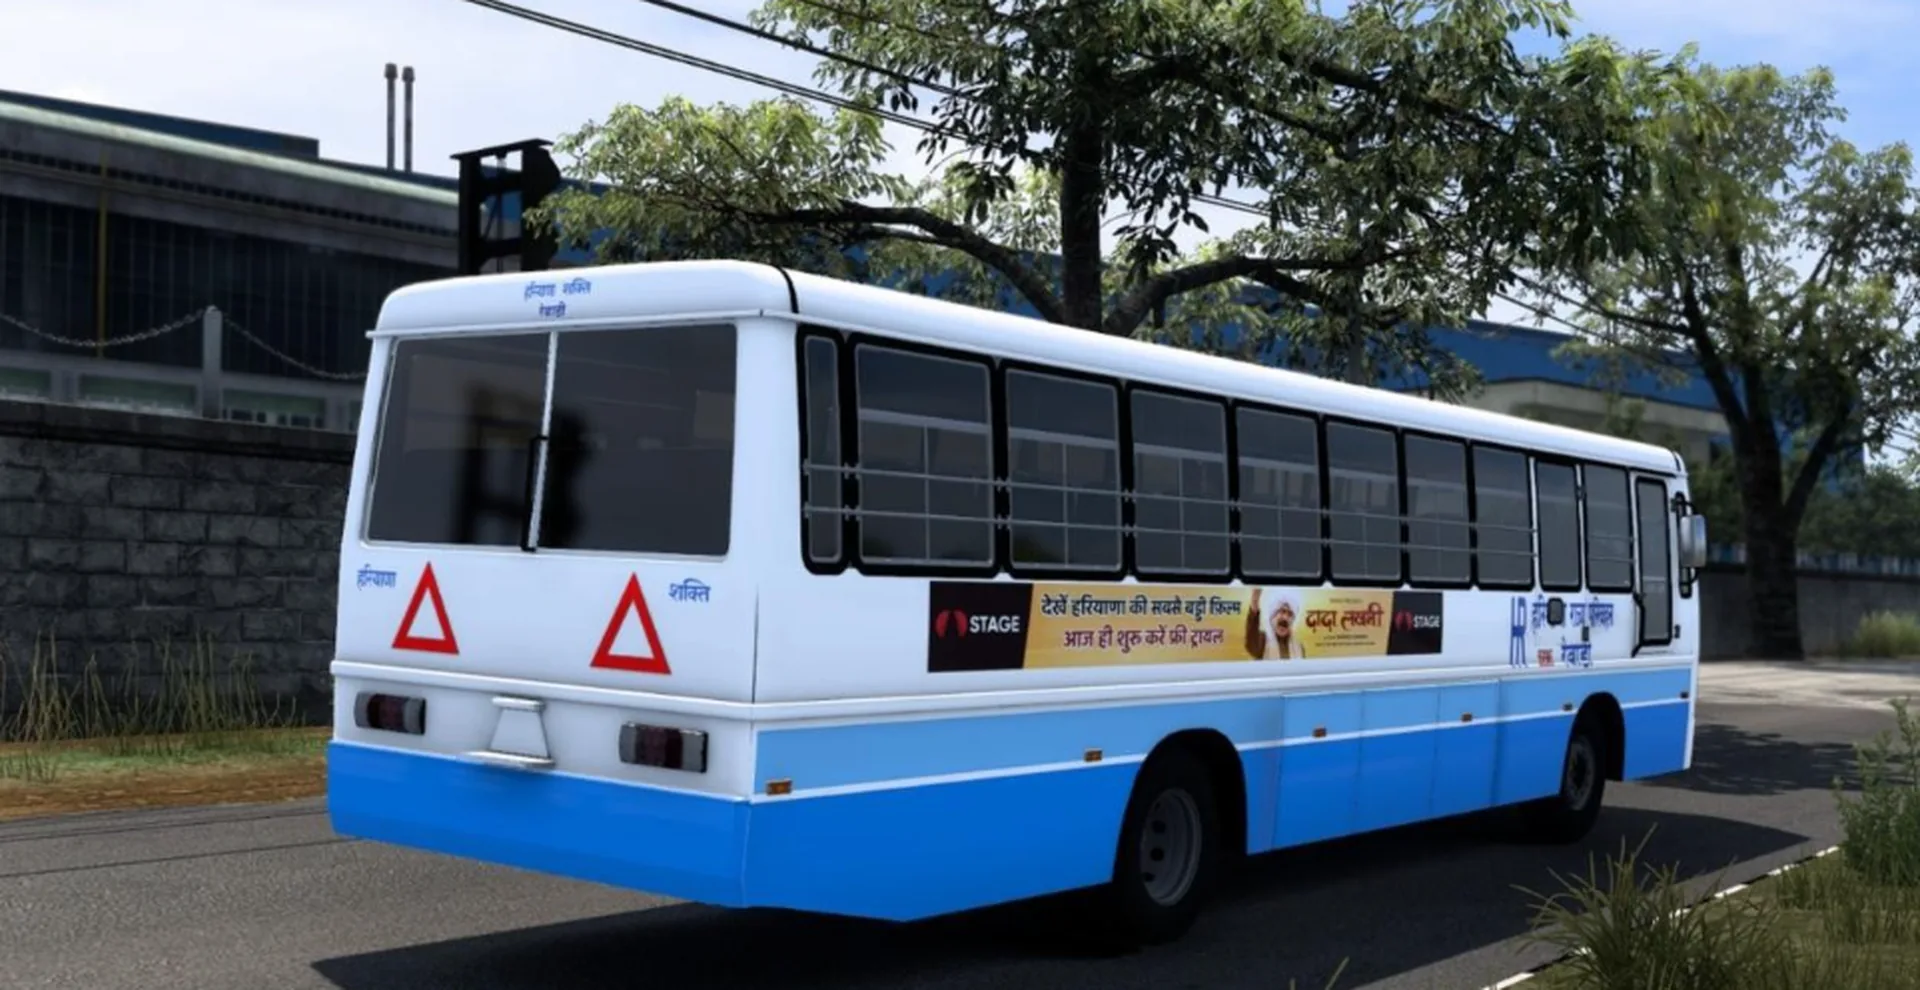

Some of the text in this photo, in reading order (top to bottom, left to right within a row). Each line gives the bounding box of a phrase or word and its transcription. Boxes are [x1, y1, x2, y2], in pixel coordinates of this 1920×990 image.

[562, 277, 592, 294] शक्ति
[668, 577, 712, 603] शक्ति
[1041, 594, 1068, 615] देखें
[1072, 594, 1126, 617] हरियाणा
[1129, 594, 1147, 615] की
[1152, 595, 1182, 615] सबसे
[969, 615, 1020, 633] STAGE
[1306, 610, 1336, 633] दादा
[1413, 614, 1441, 628] STAGE
[1064, 630, 1095, 648] आज
[1098, 624, 1112, 649] ही
[1145, 624, 1167, 645] करें
[1169, 624, 1188, 645] फ्री
[1191, 629, 1224, 648] ट्रायल
